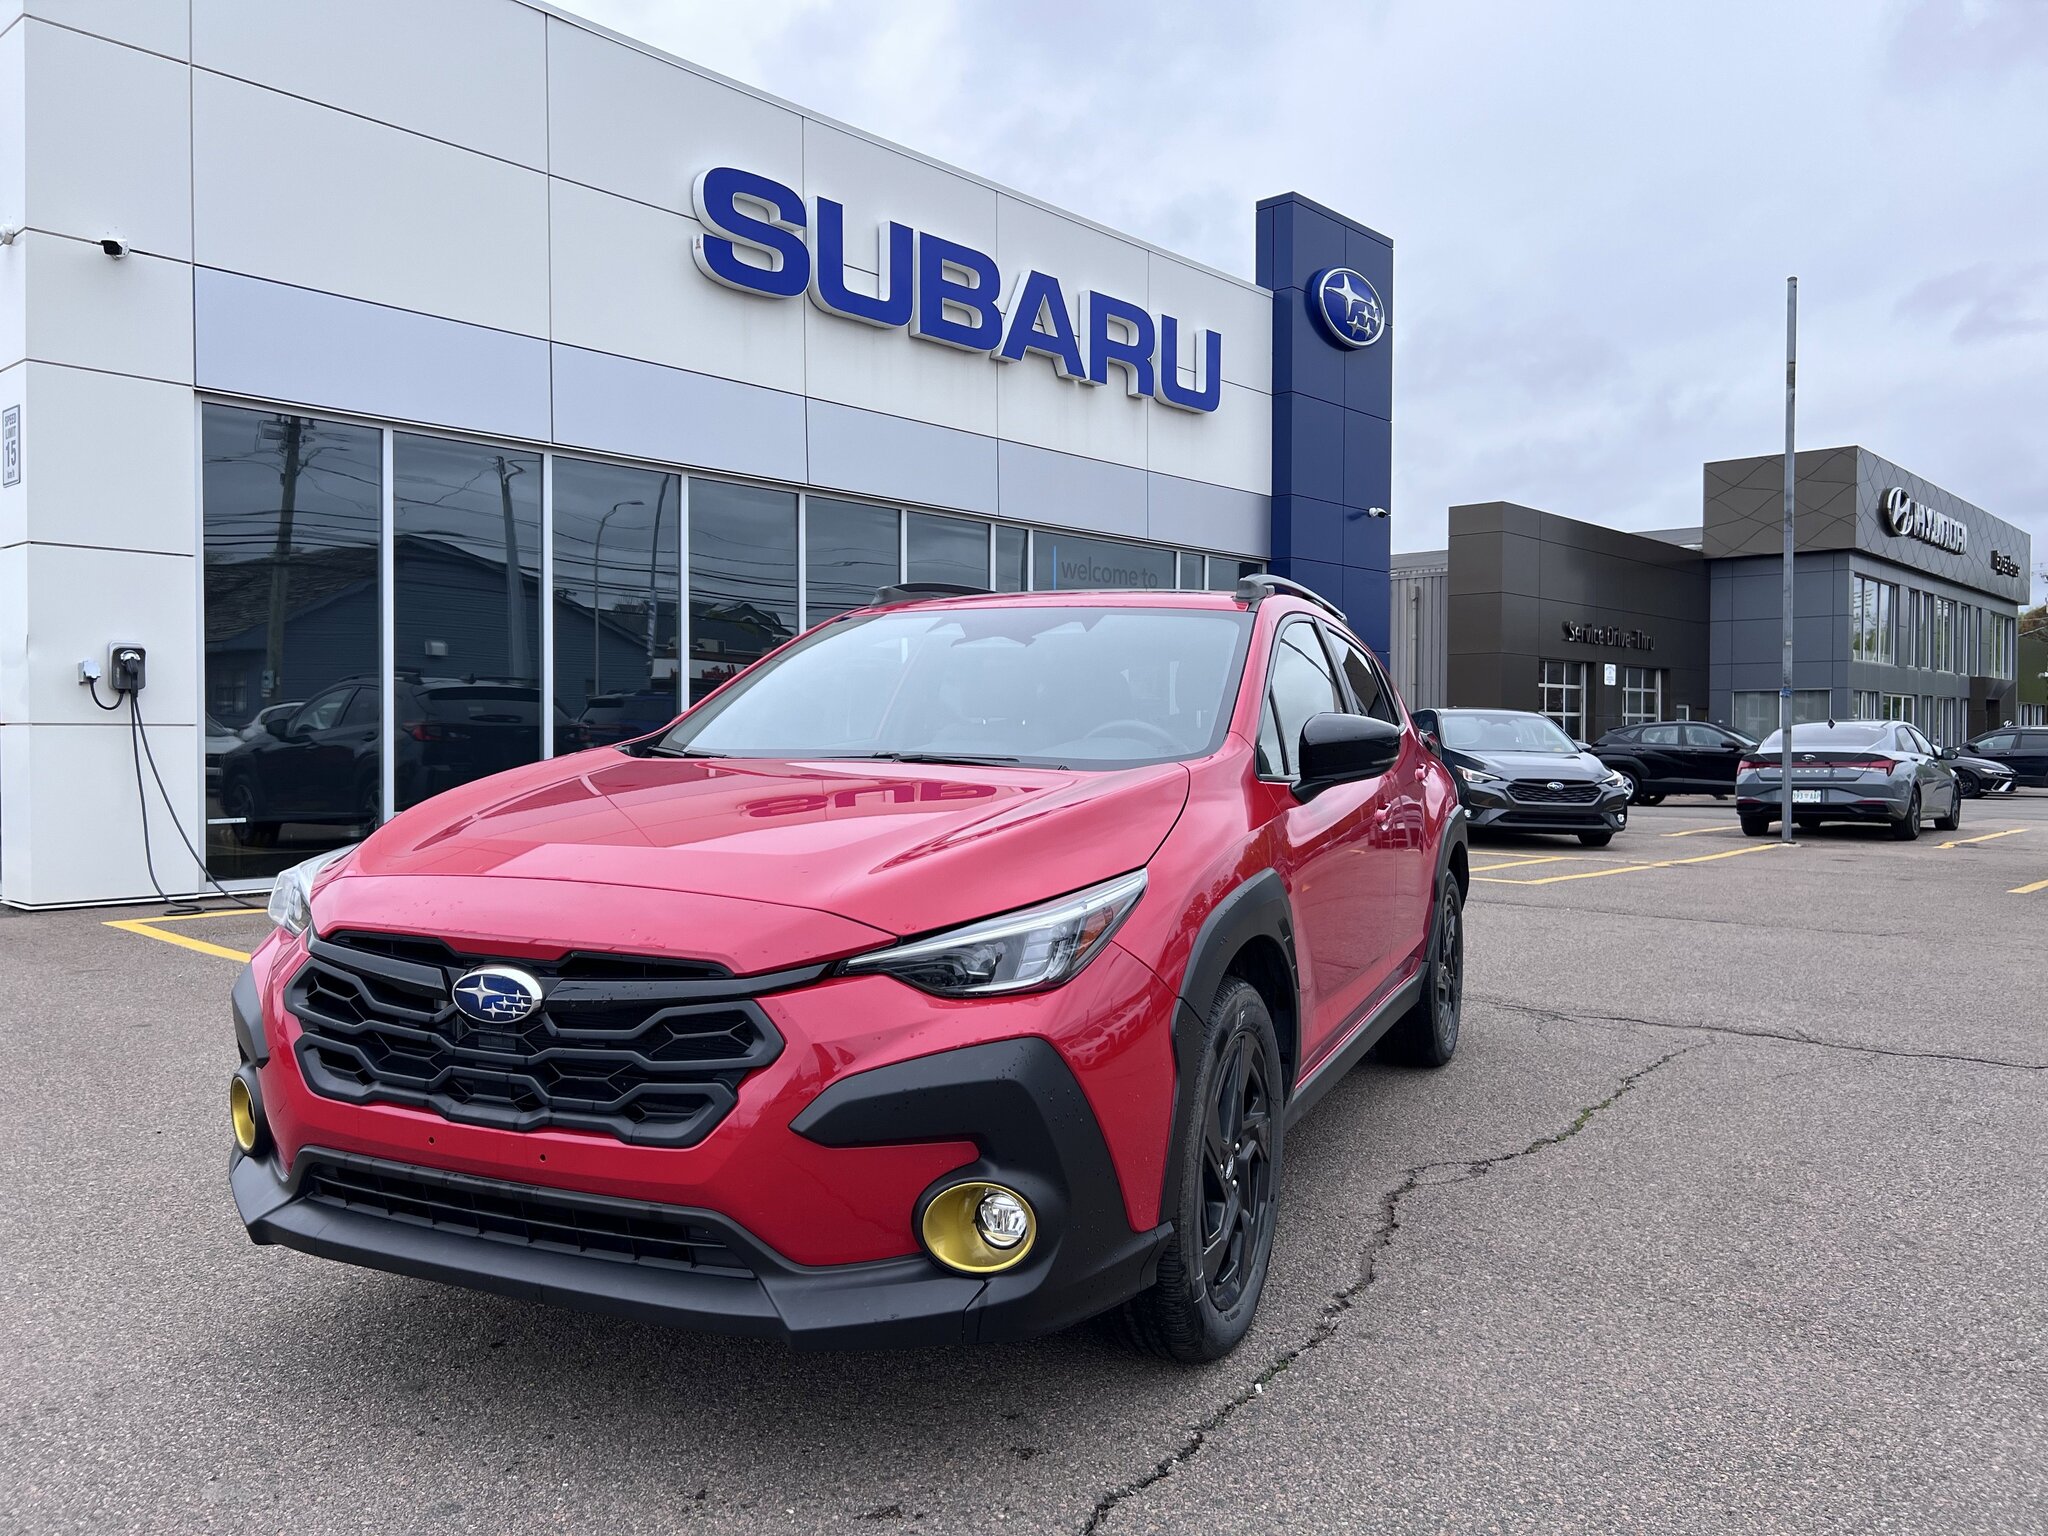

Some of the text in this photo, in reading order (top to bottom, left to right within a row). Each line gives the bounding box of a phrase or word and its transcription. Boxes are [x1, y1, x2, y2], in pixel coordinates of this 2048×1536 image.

[695, 166, 1222, 413] SUBARU
[6, 440, 16, 467] 15
[1914, 502, 1967, 553] HYUNDAI
[1061, 556, 1158, 588] welcome to
[1567, 621, 1656, 651] Service Drive-Thru
